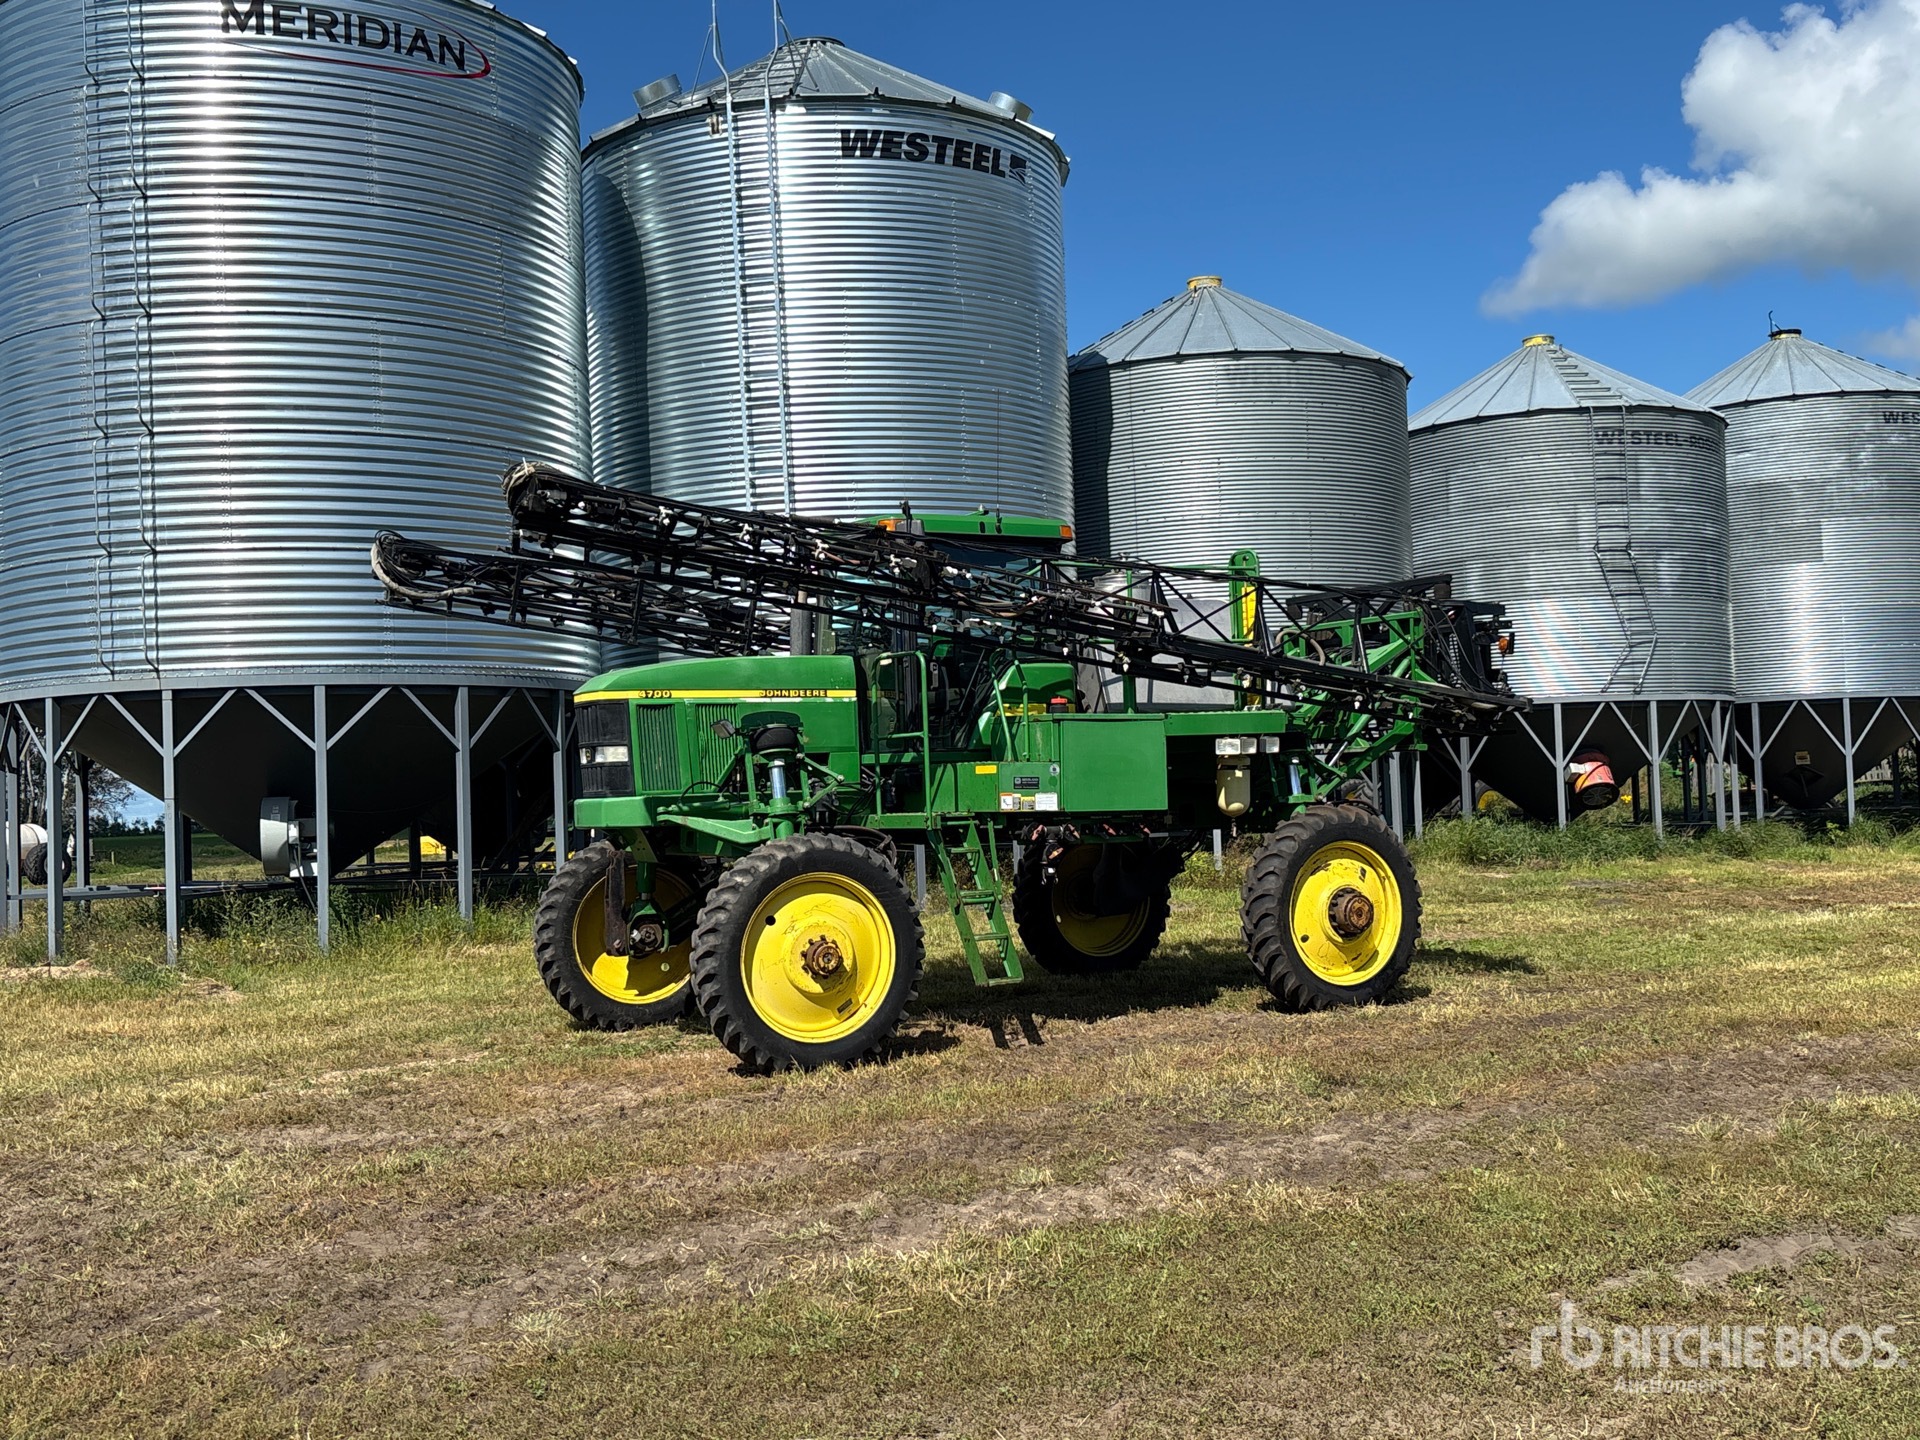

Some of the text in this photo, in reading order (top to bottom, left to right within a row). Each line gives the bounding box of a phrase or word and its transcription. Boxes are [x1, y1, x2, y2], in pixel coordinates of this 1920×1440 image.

[220, 0, 467, 72] MERIDIAN
[840, 128, 1006, 178] WESTEEL
[638, 689, 672, 699] 4700
[759, 689, 826, 698] JOHN DEERE
